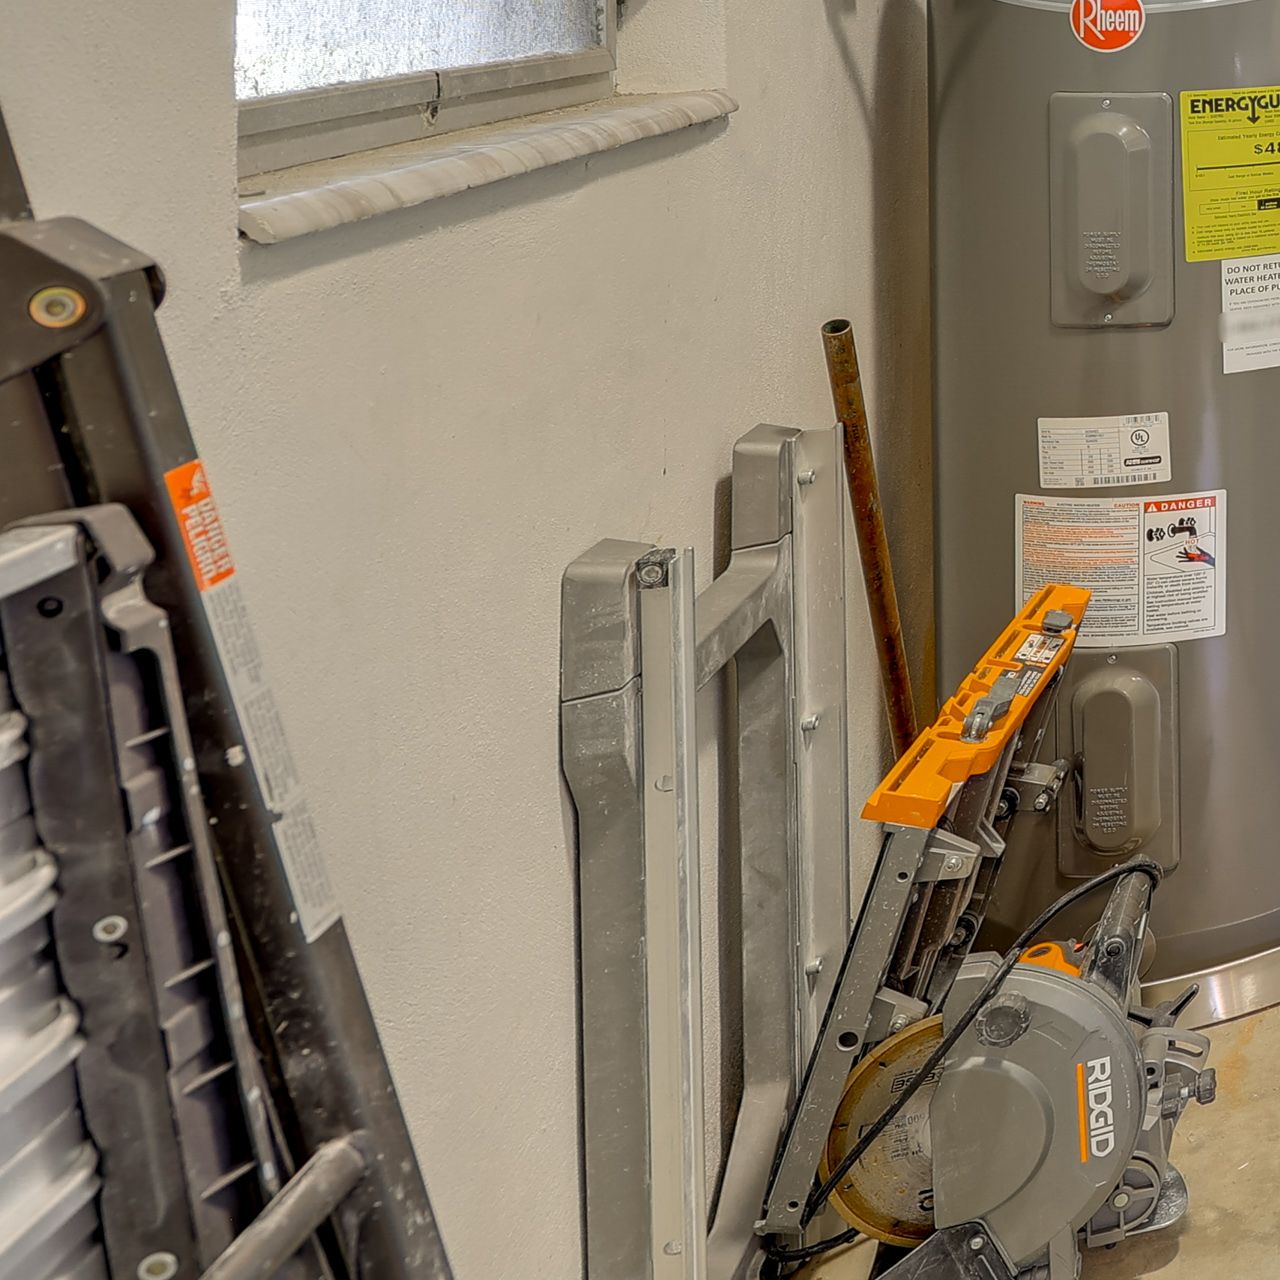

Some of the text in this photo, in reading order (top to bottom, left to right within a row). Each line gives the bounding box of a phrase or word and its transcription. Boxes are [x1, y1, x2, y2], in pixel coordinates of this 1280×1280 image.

[1227, 266, 1240, 274] DO
[1243, 264, 1260, 273] NOT
[1225, 275, 1254, 285] WATER
[1229, 287, 1255, 296] PLACE
[1258, 285, 1269, 293] OF
[1161, 499, 1212, 510] DANGER
[1087, 1056, 1115, 1158] RIDGID
